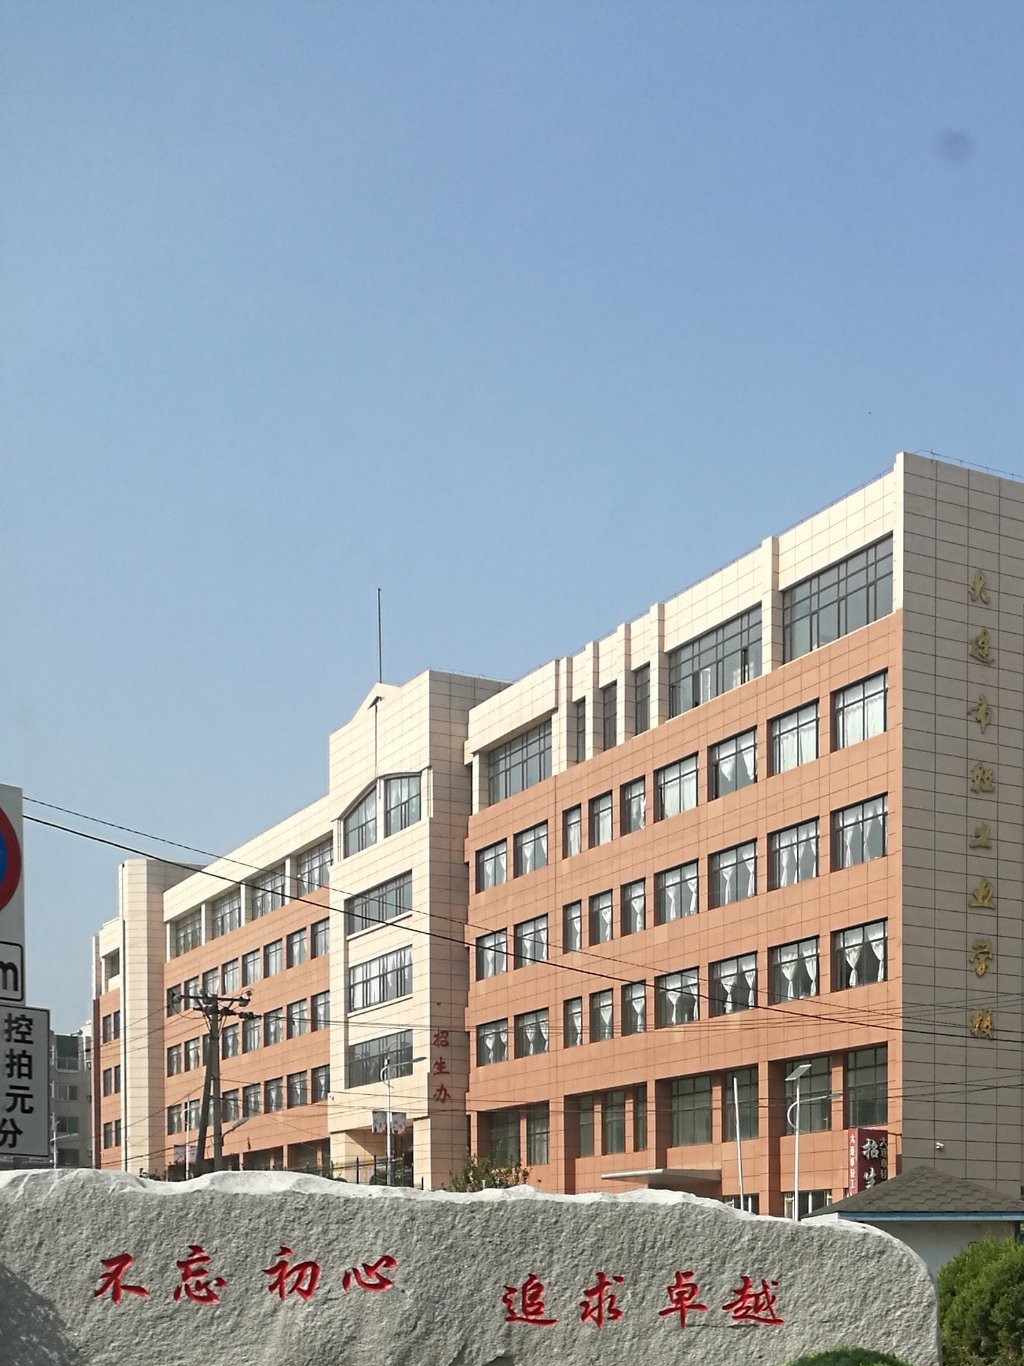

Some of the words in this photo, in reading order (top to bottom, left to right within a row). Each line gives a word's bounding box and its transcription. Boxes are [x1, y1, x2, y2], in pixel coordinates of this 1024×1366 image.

[432, 1027, 450, 1104] 招生办
[862, 1138, 880, 1189] 招生
[93, 1244, 398, 1305] 不忘初心
[501, 1270, 785, 1328] 追求卓越
